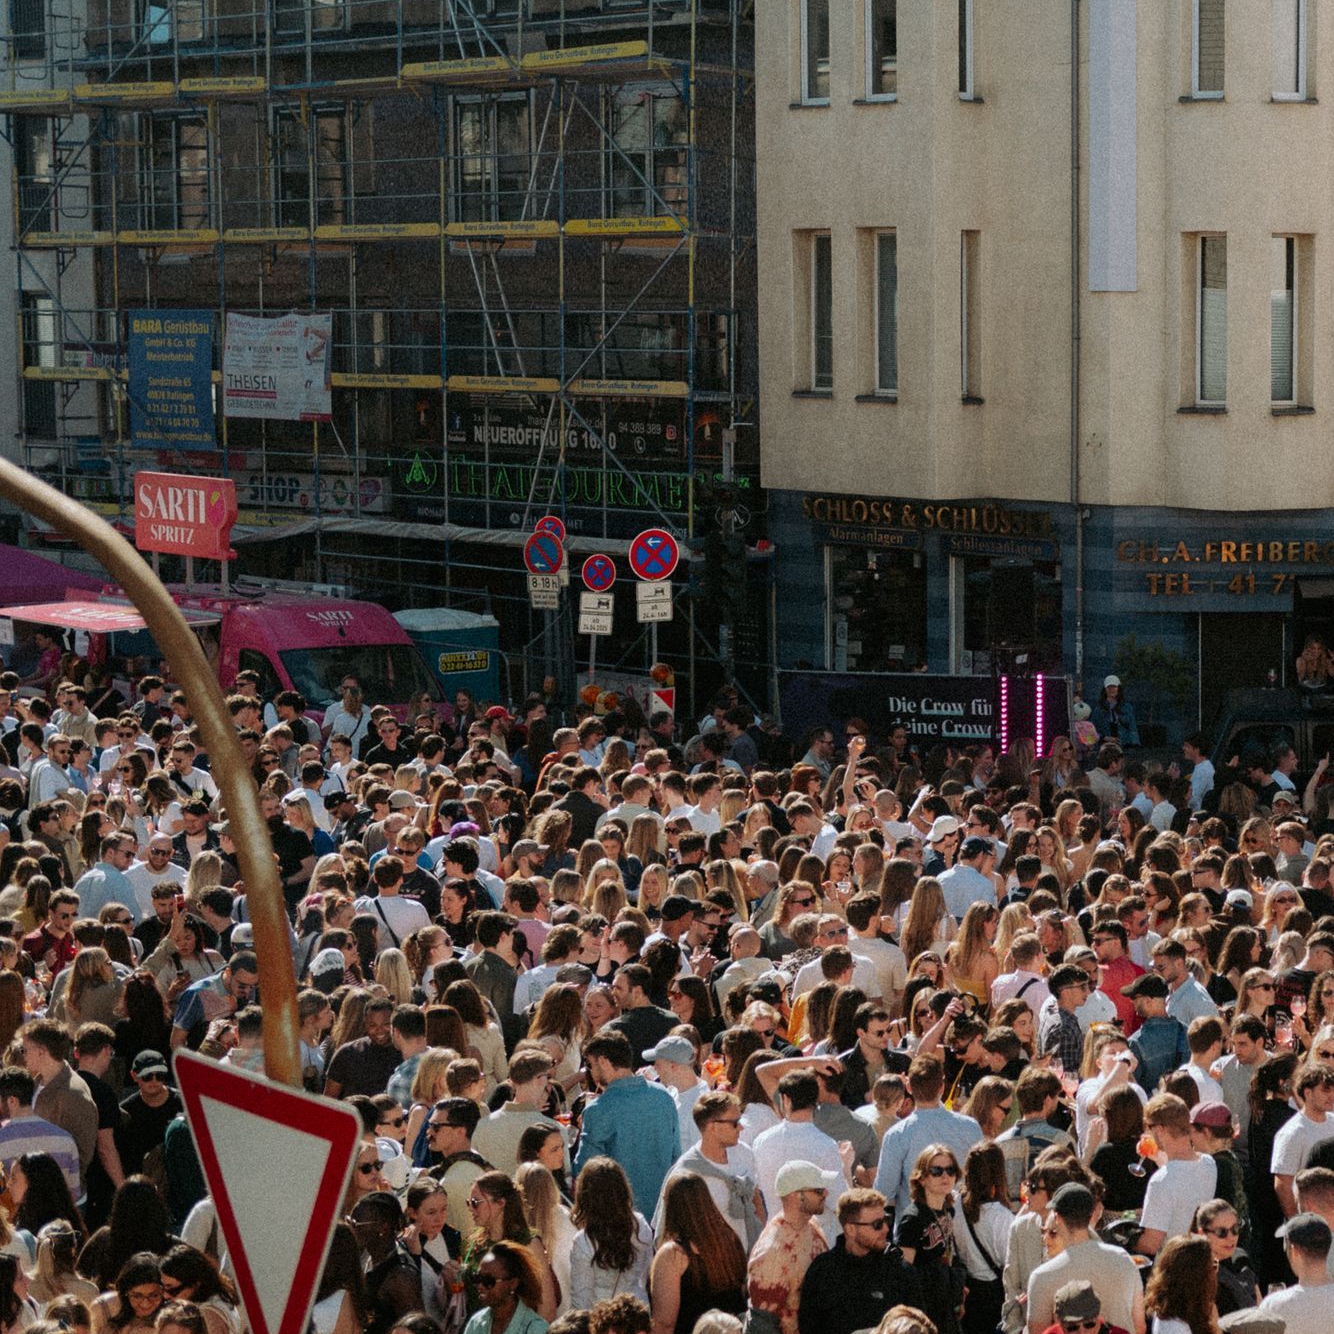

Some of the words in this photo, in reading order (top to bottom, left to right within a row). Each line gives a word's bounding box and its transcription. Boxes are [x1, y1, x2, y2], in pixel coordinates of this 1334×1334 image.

[133, 319, 162, 334] BARA
[227, 373, 277, 390] THEISEN
[618, 422, 629, 432] 94
[629, 423, 645, 434] 389
[647, 424, 662, 435] 389
[138, 482, 206, 524] SARTI
[802, 496, 893, 526] SCHLOSS
[900, 504, 917, 527] &
[149, 522, 195, 546] SPRITZ
[829, 528, 904, 546] Alarmanlagen
[306, 610, 354, 622] SARTI
[888, 696, 917, 713] Die
[920, 696, 966, 715] Crow
